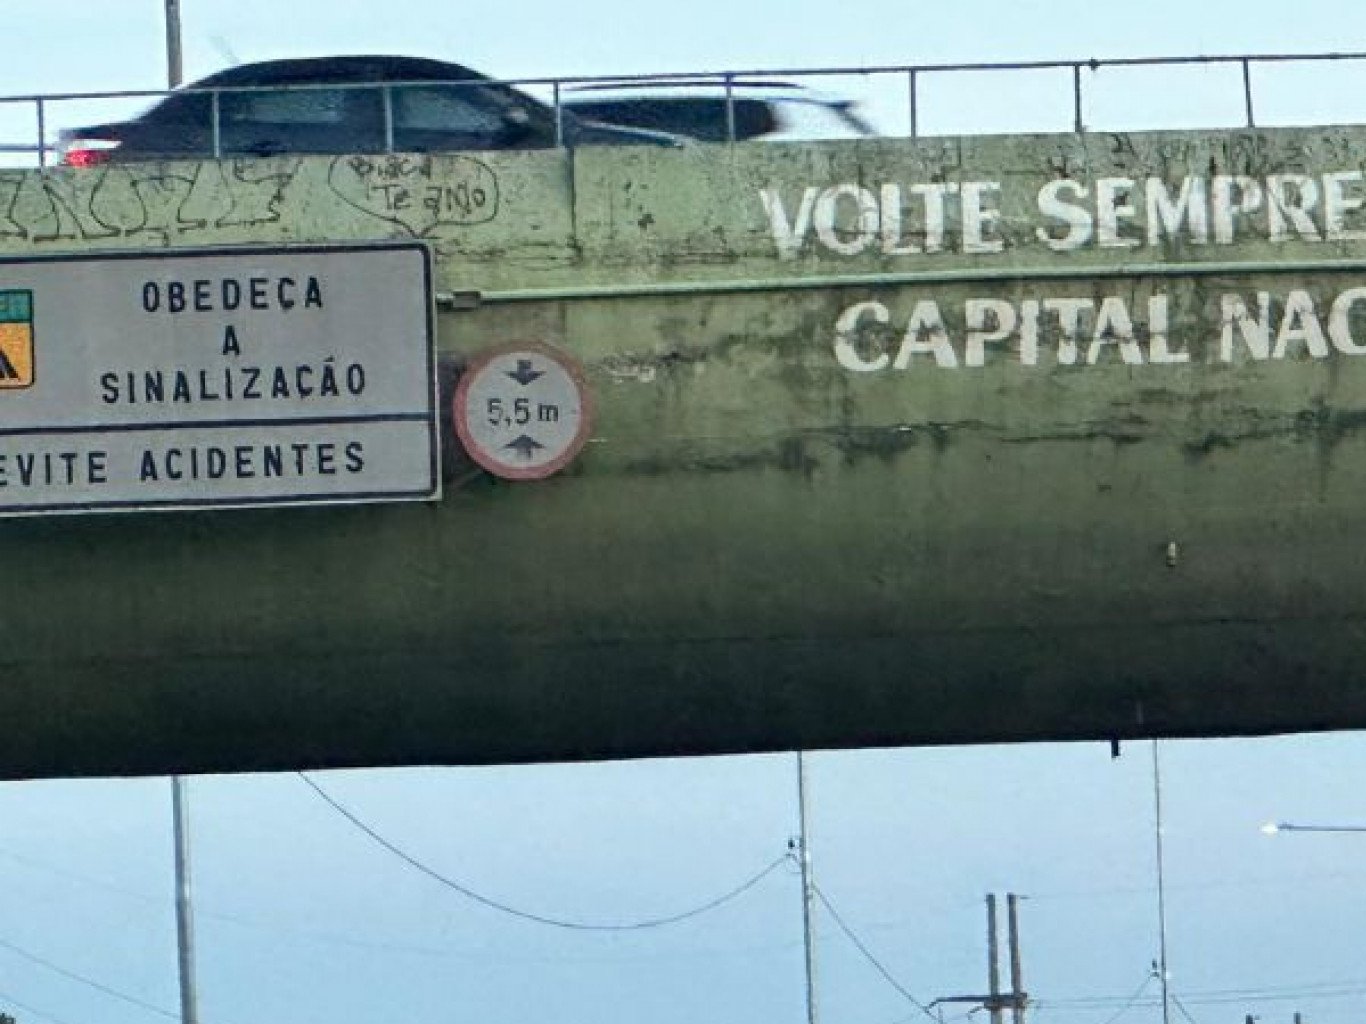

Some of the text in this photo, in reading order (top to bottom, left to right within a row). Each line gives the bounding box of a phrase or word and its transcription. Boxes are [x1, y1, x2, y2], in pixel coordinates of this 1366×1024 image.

[760, 181, 1002, 260] VOLTE
[222, 324, 241, 357] A
[833, 295, 1190, 372] CAPITAL
[101, 355, 367, 405] SINALIZAÇÃO
[140, 441, 366, 482] ACIDENTES
